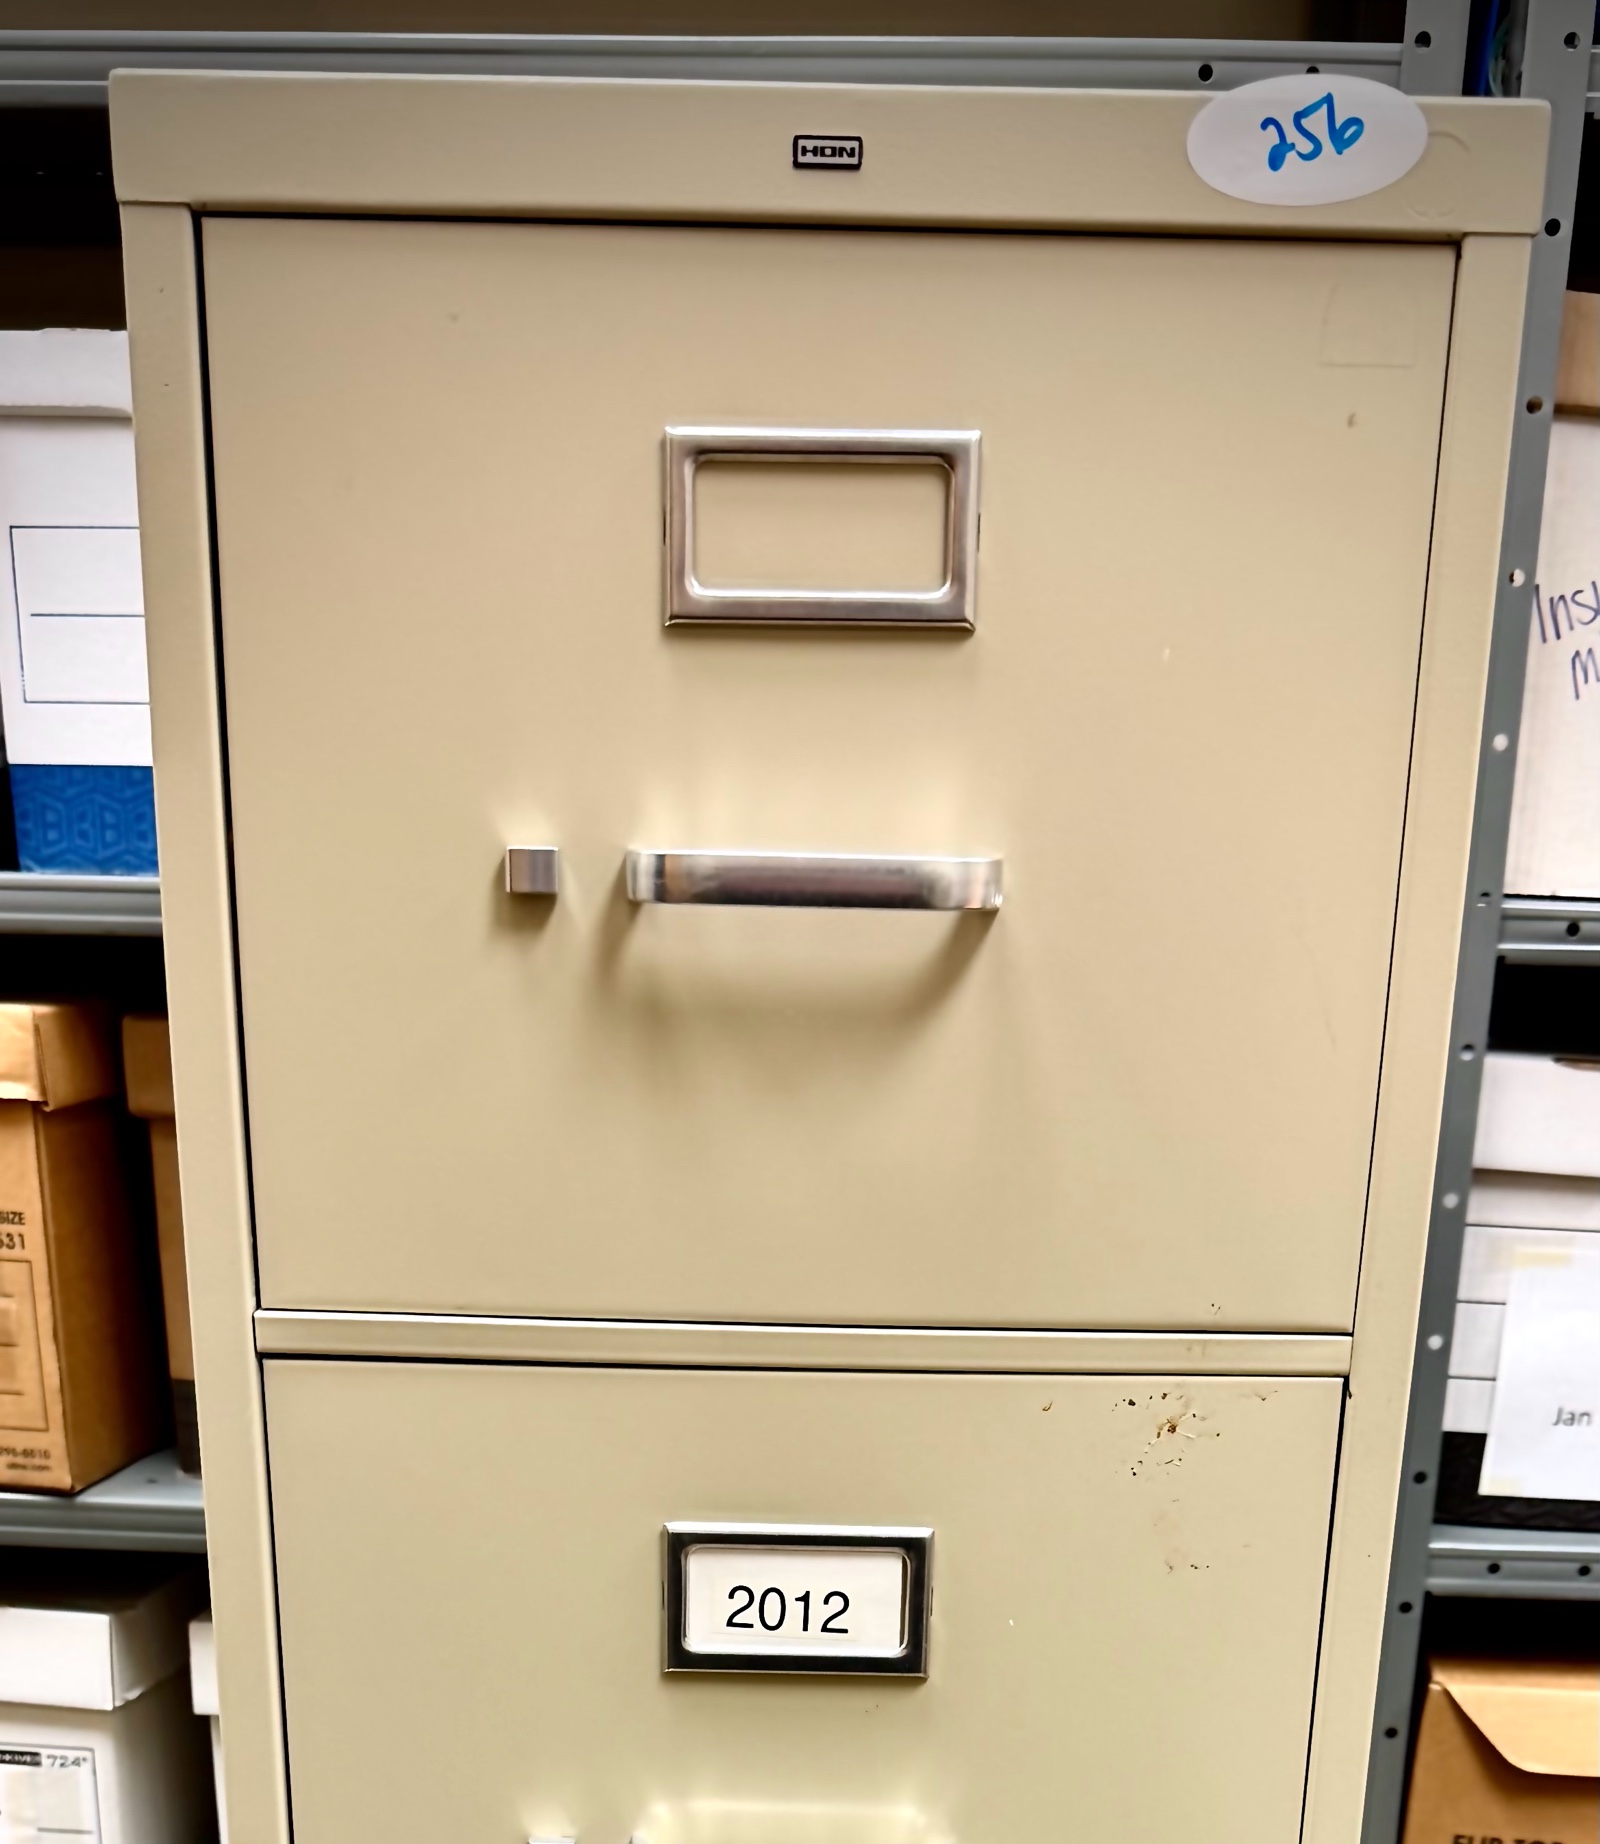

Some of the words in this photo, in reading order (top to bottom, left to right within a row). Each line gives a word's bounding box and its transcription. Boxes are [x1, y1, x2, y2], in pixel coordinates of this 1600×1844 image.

[1260, 92, 1364, 172] 256
[800, 145, 857, 159] HON
[1552, 1406, 1592, 1427] Jan
[726, 1585, 850, 1634] 2012
